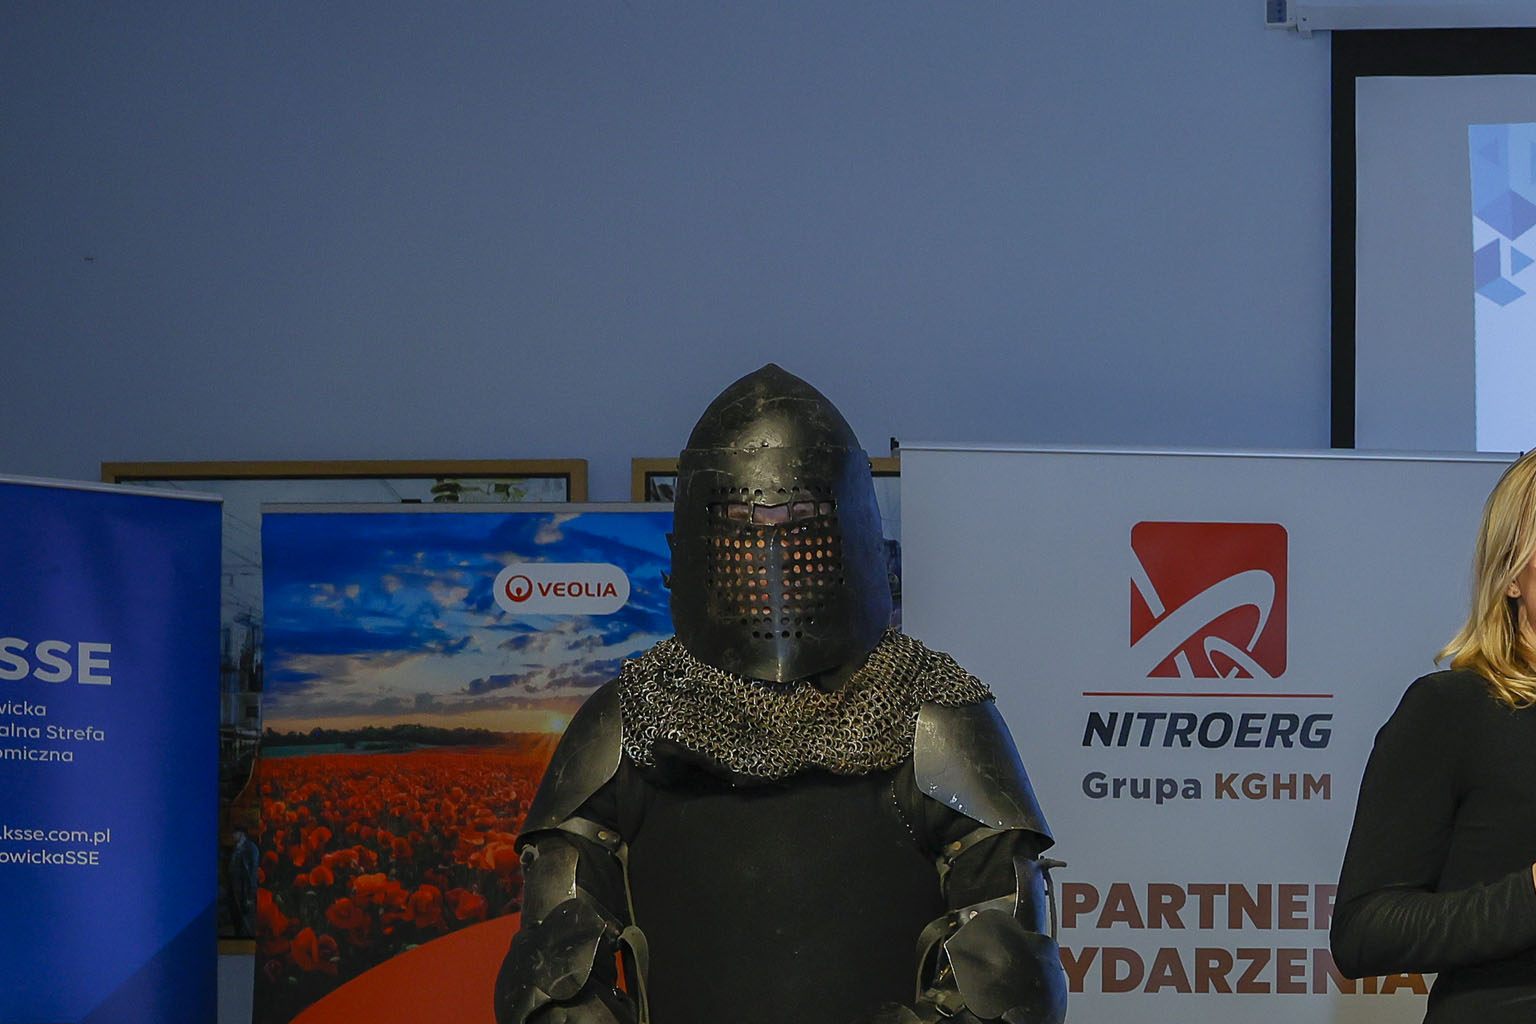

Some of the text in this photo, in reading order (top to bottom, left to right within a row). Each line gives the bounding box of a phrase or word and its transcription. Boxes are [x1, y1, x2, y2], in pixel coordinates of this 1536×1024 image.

[537, 582, 619, 598] VEOLIA
[46, 724, 106, 742] Strefa
[1082, 711, 1333, 748] NITROERG
[0, 745, 74, 763] miczna
[1082, 771, 1332, 804] Grupa KGHM
